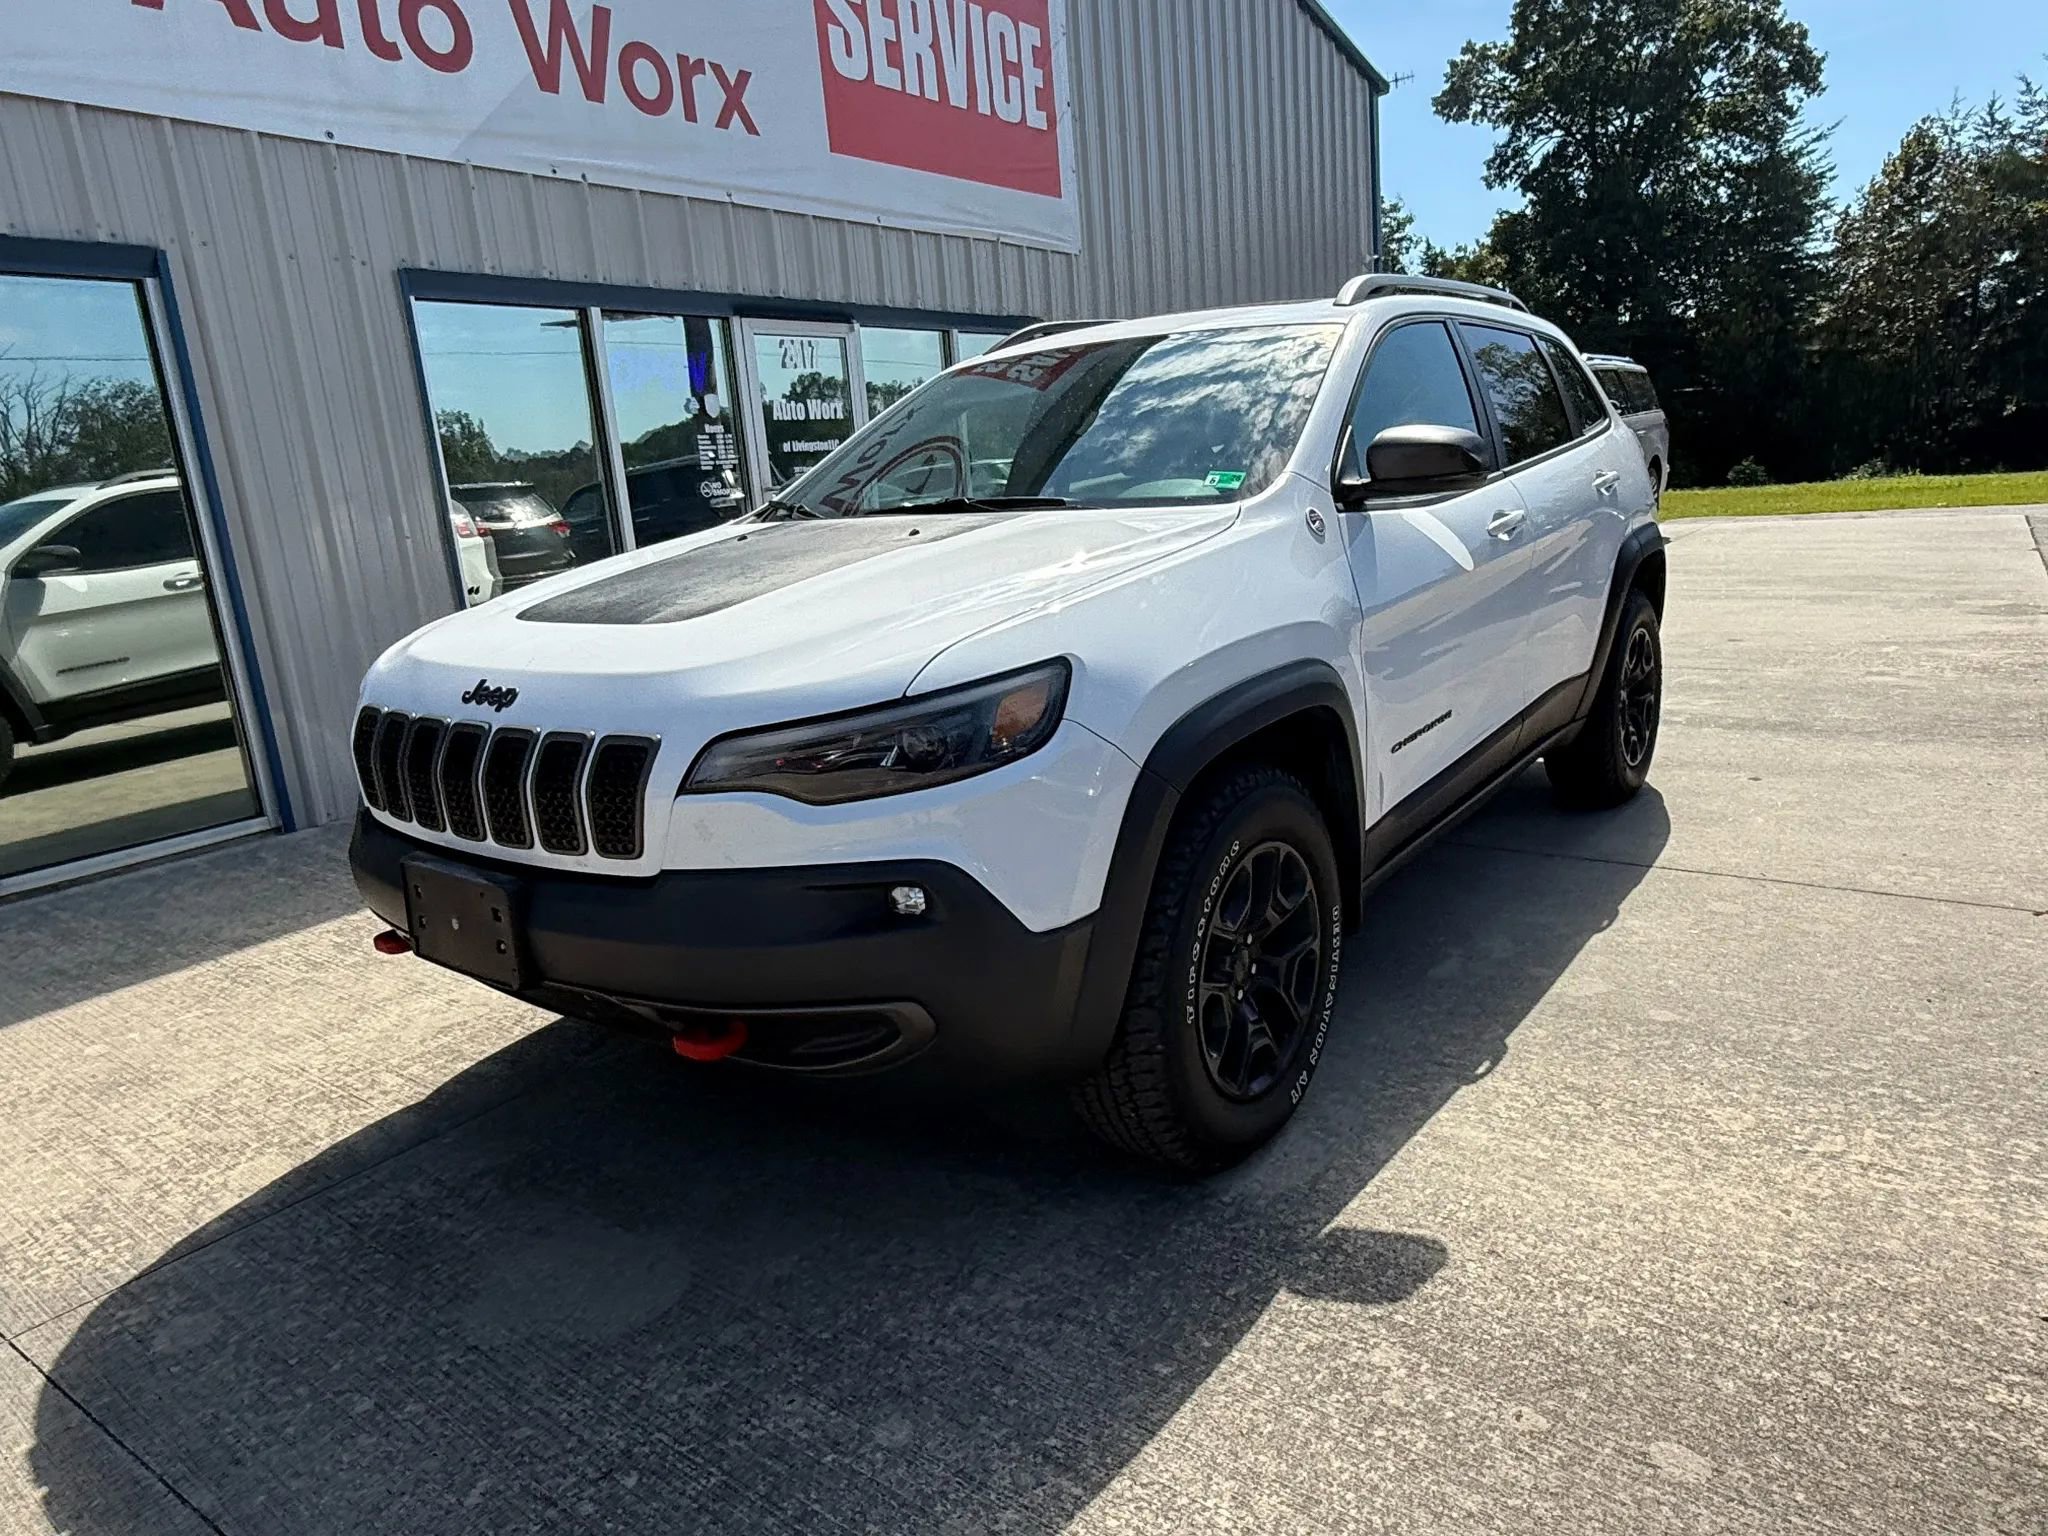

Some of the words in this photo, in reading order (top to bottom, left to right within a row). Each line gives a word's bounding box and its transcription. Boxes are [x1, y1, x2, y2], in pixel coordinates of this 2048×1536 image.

[131, 0, 473, 73] uto
[508, 0, 760, 136] Worx
[826, 0, 1048, 130] SERVICE
[773, 400, 805, 421] Auto
[783, 441, 791, 452] of
[791, 440, 828, 452] Livingston
[461, 679, 520, 713] Jeep
[1309, 904, 1342, 1066] DESTINATION
[1290, 1069, 1309, 1105] A/T
